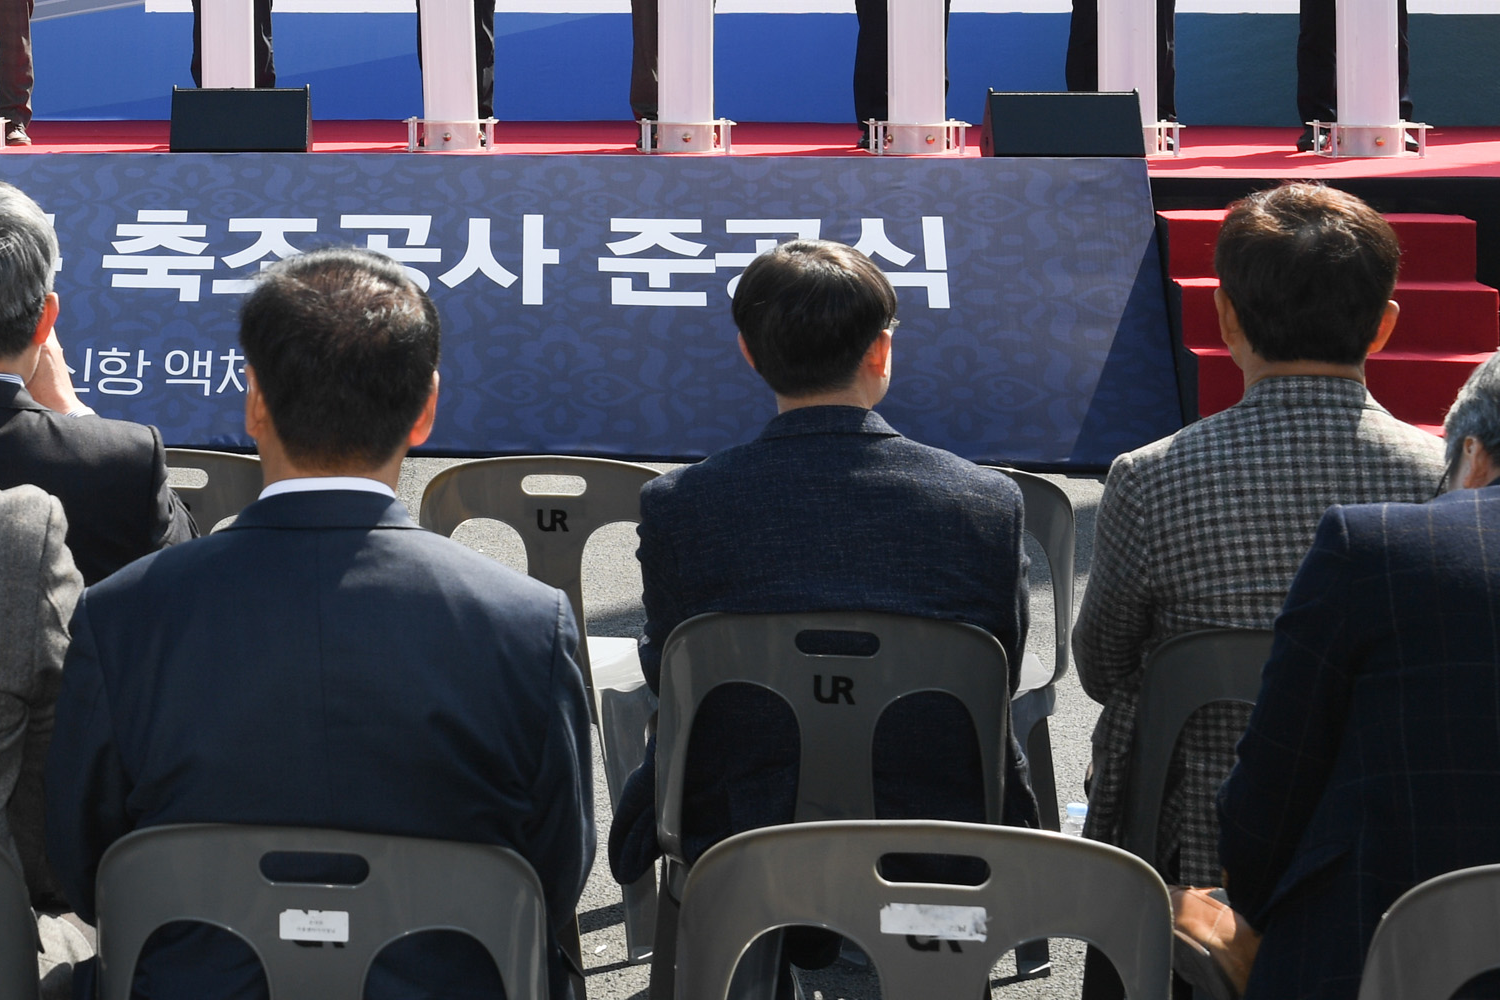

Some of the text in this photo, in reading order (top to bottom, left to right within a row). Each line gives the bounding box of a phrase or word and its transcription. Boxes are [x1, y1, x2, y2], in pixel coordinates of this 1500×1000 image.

[65, 347, 151, 395] 신항
[536, 508, 570, 533] UR
[812, 674, 856, 706] UR
